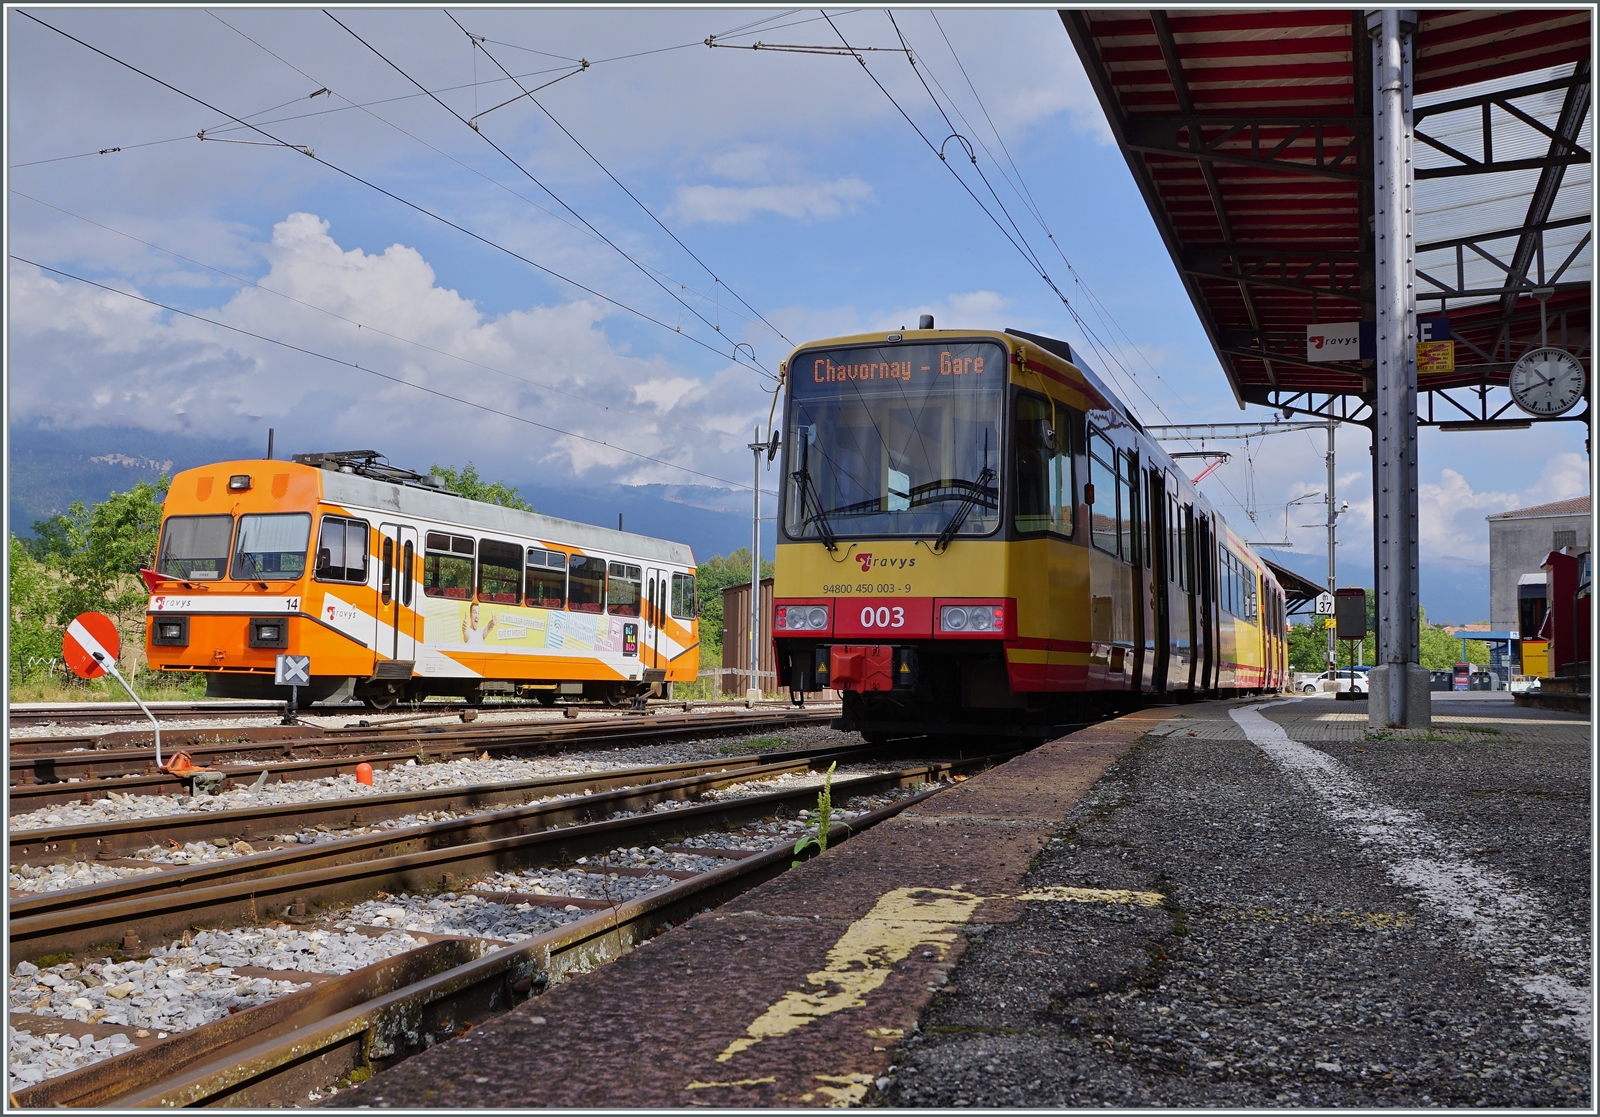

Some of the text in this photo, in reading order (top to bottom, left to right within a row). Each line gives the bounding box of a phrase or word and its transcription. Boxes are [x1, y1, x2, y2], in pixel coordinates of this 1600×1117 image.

[814, 359, 911, 383] Chavornay
[940, 351, 984, 375] Gare
[858, 554, 916, 571] travys
[823, 584, 852, 594] 94800
[855, 584, 873, 593] 450
[876, 583, 895, 593] 003
[904, 583, 911, 593] 9
[286, 598, 298, 610] 14
[1319, 601, 1332, 613] 37
[860, 606, 905, 628] 003
